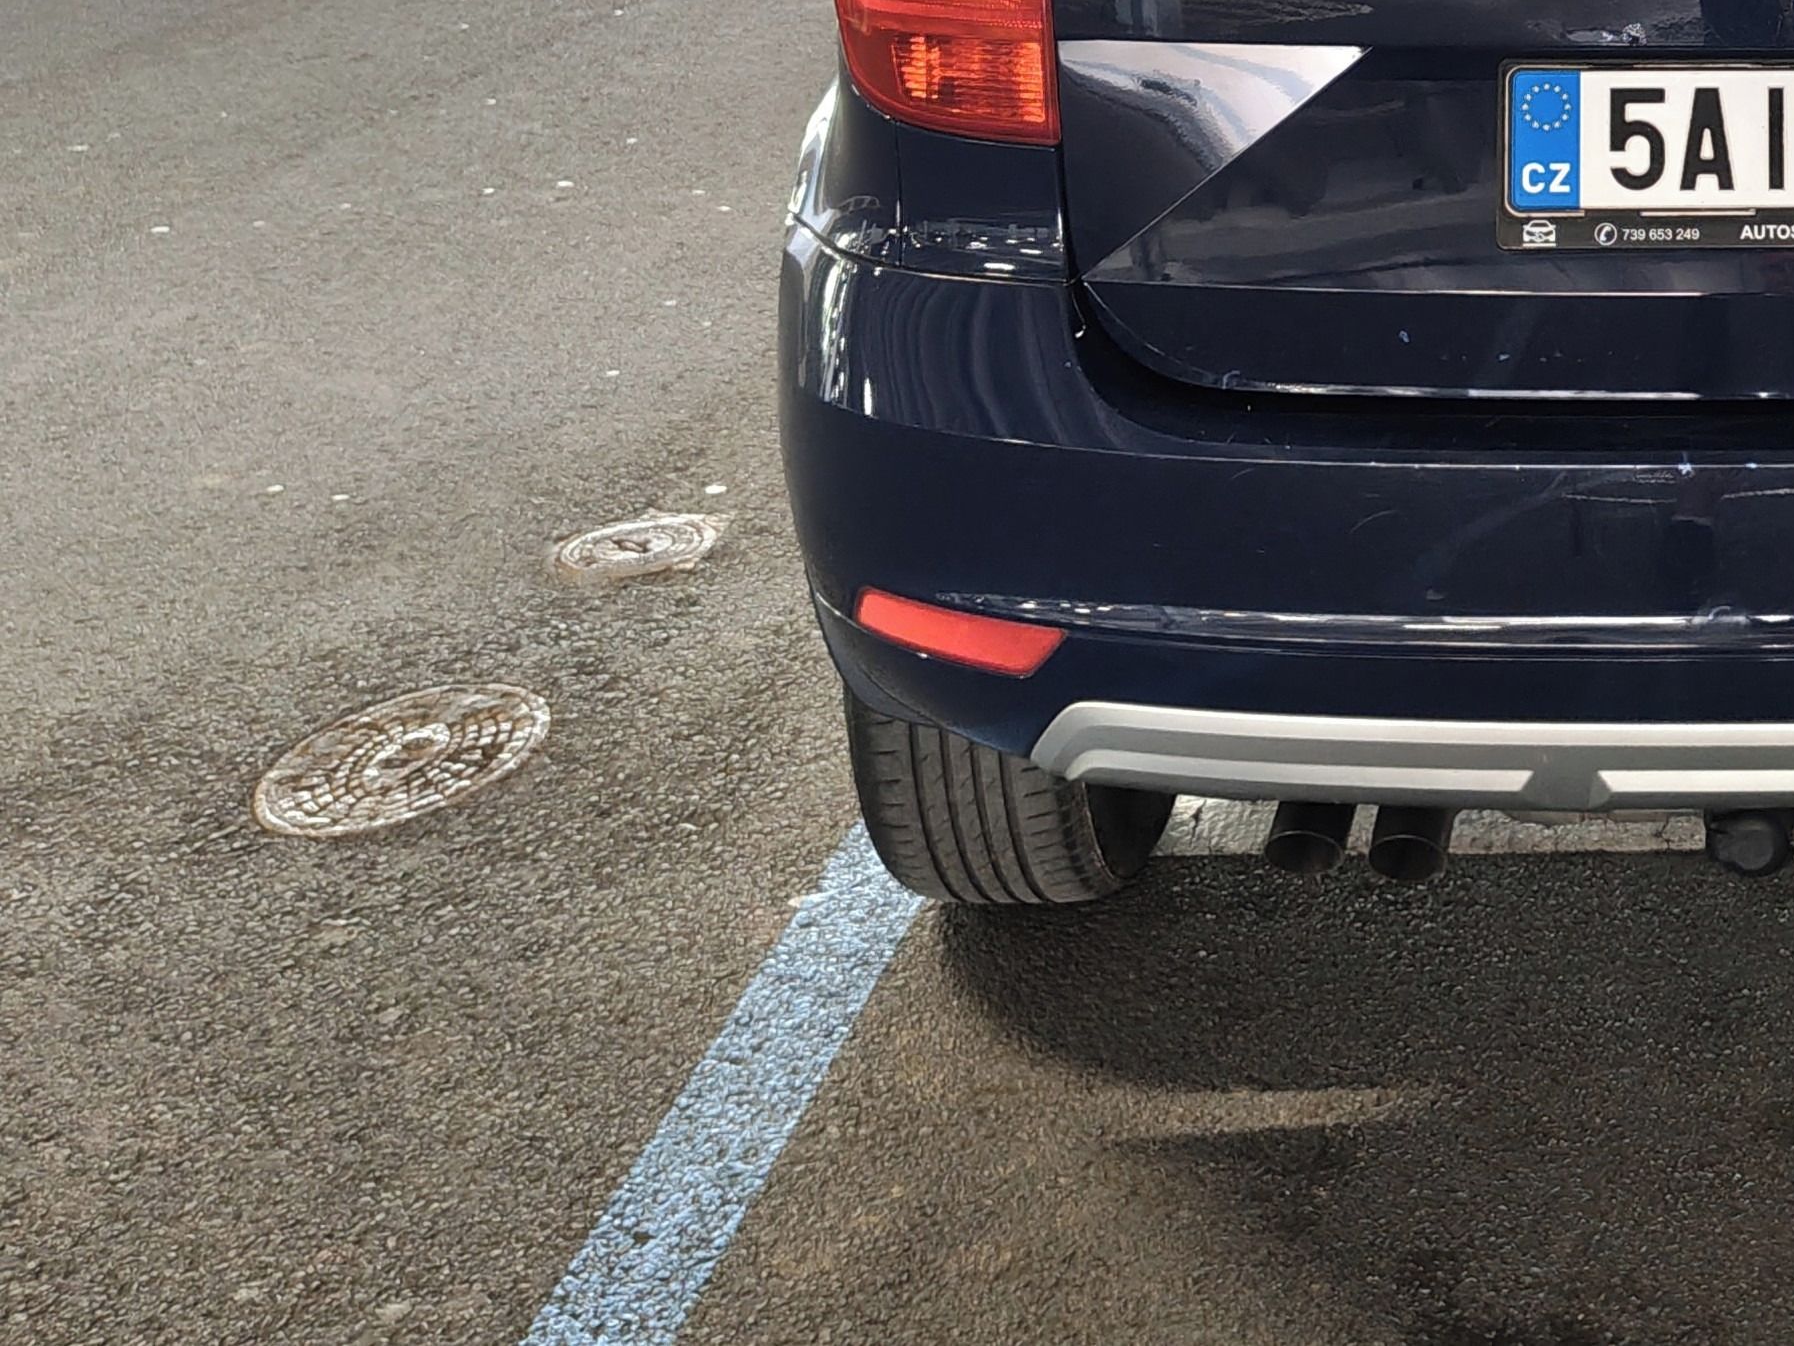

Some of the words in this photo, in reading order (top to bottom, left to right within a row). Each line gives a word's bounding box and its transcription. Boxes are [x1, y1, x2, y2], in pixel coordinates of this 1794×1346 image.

[1609, 86, 1786, 192] 5AI
[1522, 162, 1571, 194] CZ
[1622, 228, 1646, 241] 739
[1649, 228, 1673, 241] 653
[1675, 228, 1700, 241] 249
